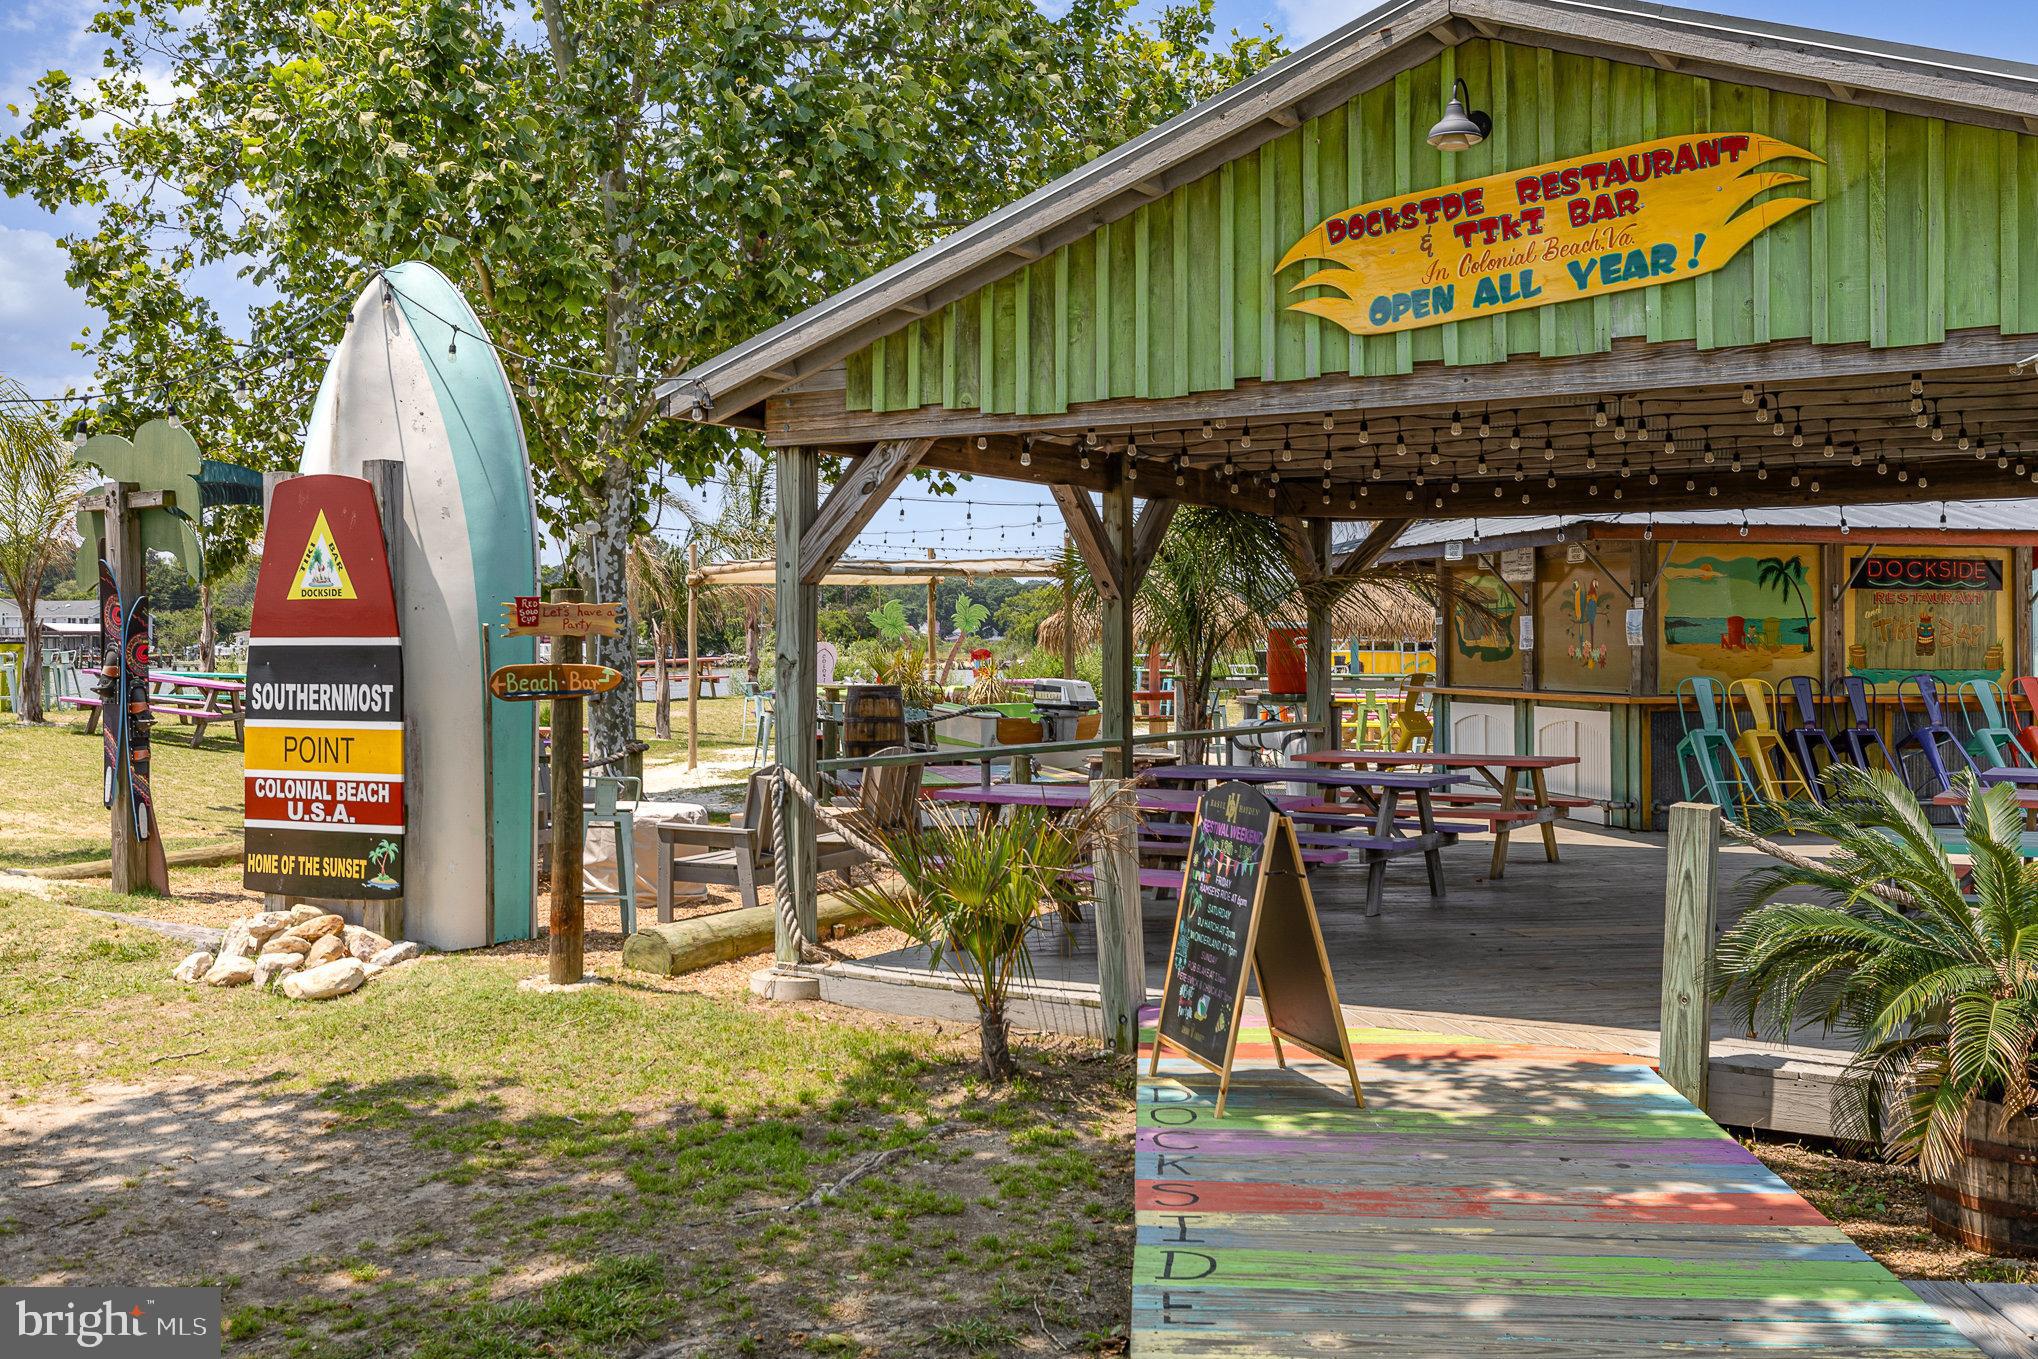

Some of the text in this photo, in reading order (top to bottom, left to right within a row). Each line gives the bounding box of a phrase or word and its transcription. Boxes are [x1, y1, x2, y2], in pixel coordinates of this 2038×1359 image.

[1326, 135, 1749, 246] DOCKSIDE RESTAURANT
[1453, 187, 1640, 249] TIKI BAR
[1419, 226, 1434, 258] &
[1421, 259, 1449, 285] In
[1458, 240, 1537, 279] Colonial
[1368, 283, 1455, 327] OPEN
[1472, 268, 1542, 309] ALL
[300, 542, 343, 572] TIKI BAR
[1867, 559, 1986, 579] DOCKSIDE
[301, 588, 342, 597] DOCKSIDE
[1873, 591, 1985, 605] RESTAURANT
[542, 606, 570, 618] Let's
[577, 605, 602, 617] have
[562, 618, 592, 632] Party
[506, 669, 600, 692] Beach Bar
[251, 682, 394, 713] SOUTHERNMOST
[284, 736, 355, 764] POINT
[255, 778, 390, 803] COLONIAL BEACH
[287, 801, 356, 824] U.S.A.
[1230, 825, 1264, 845] WEEKEND
[247, 853, 368, 880] HOME OF THE SUNSET
[1215, 875, 1233, 889] FRIDAY
[1206, 903, 1232, 920] SATURDAY
[1151, 1086, 1217, 1327] DOCKSIDE
